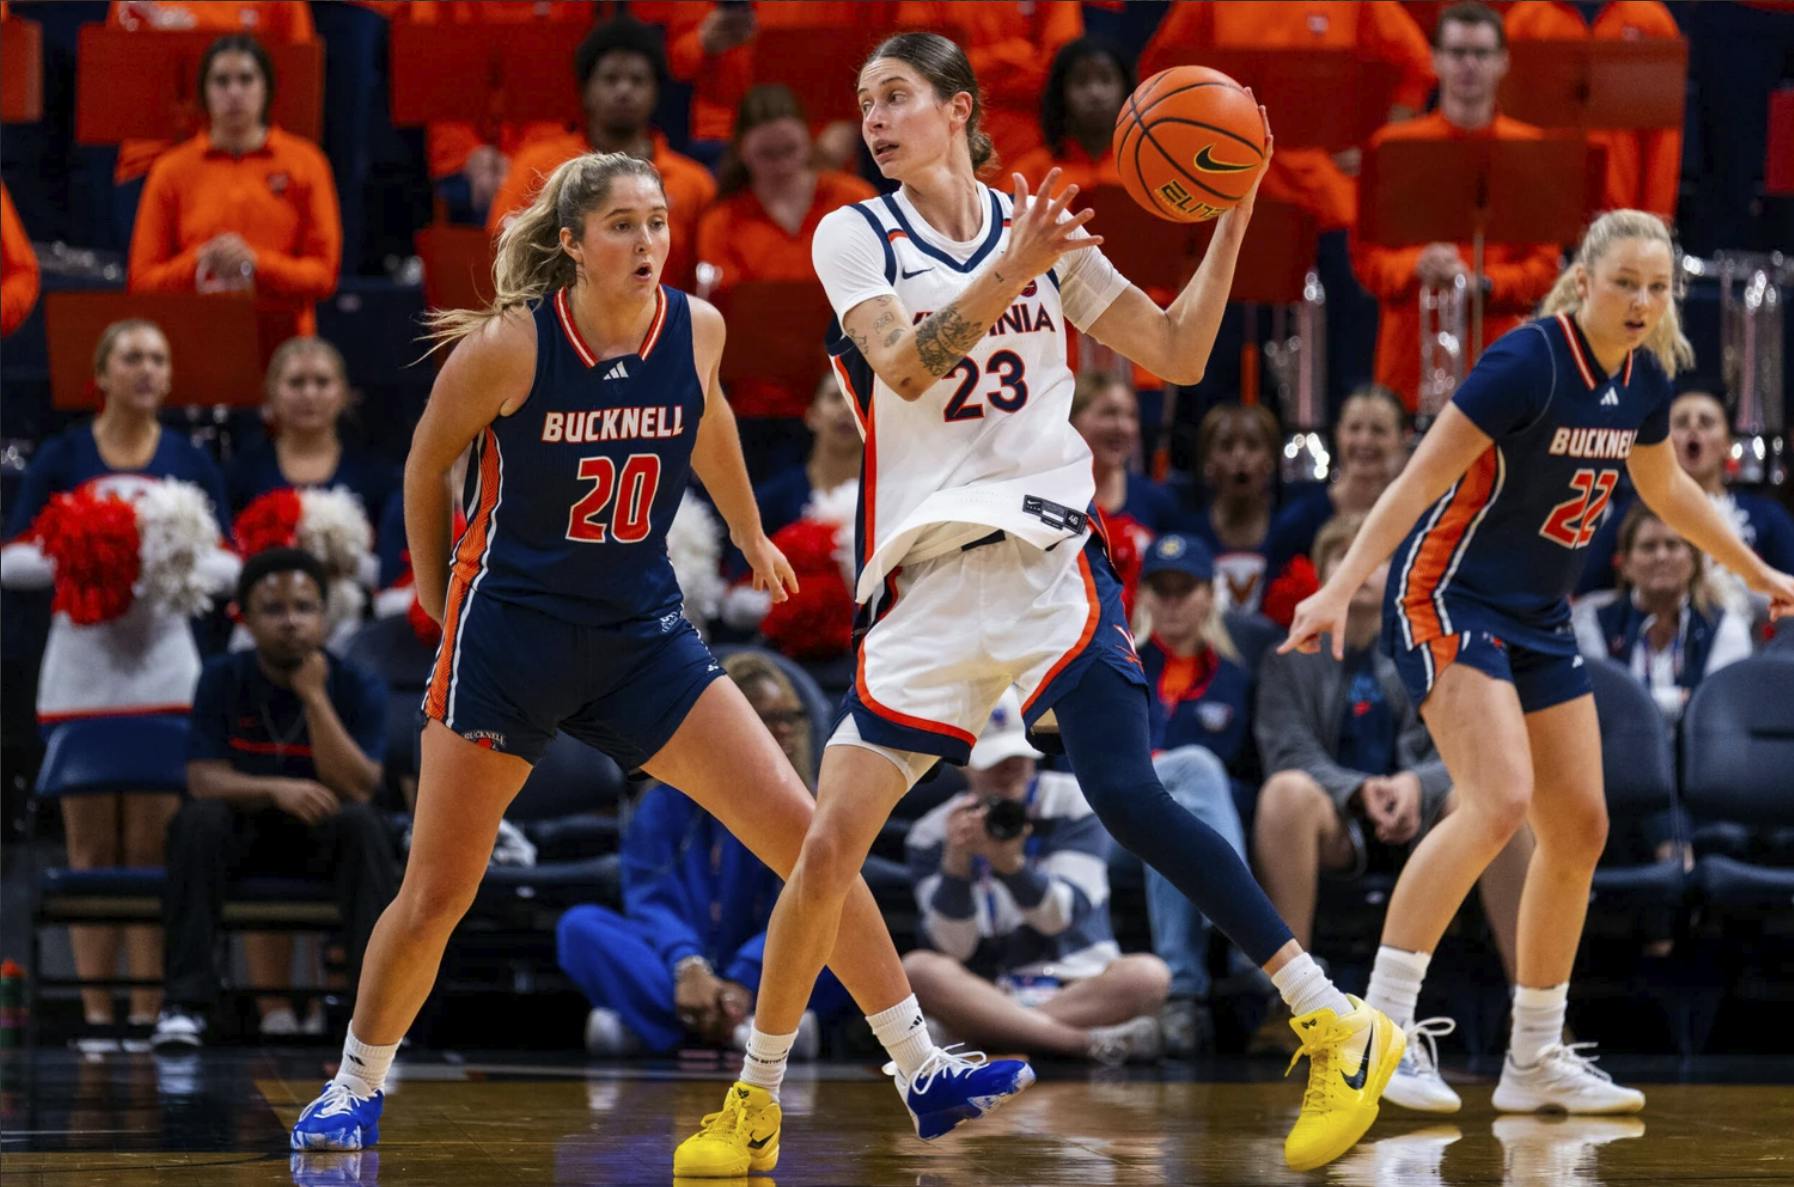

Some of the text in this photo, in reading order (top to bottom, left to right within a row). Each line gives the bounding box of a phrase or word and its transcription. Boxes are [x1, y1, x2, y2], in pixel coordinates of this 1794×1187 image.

[541, 405, 684, 443] BUCKNELL
[942, 349, 1029, 423] 23
[565, 453, 661, 543] 20
[1539, 468, 1619, 550] 22
